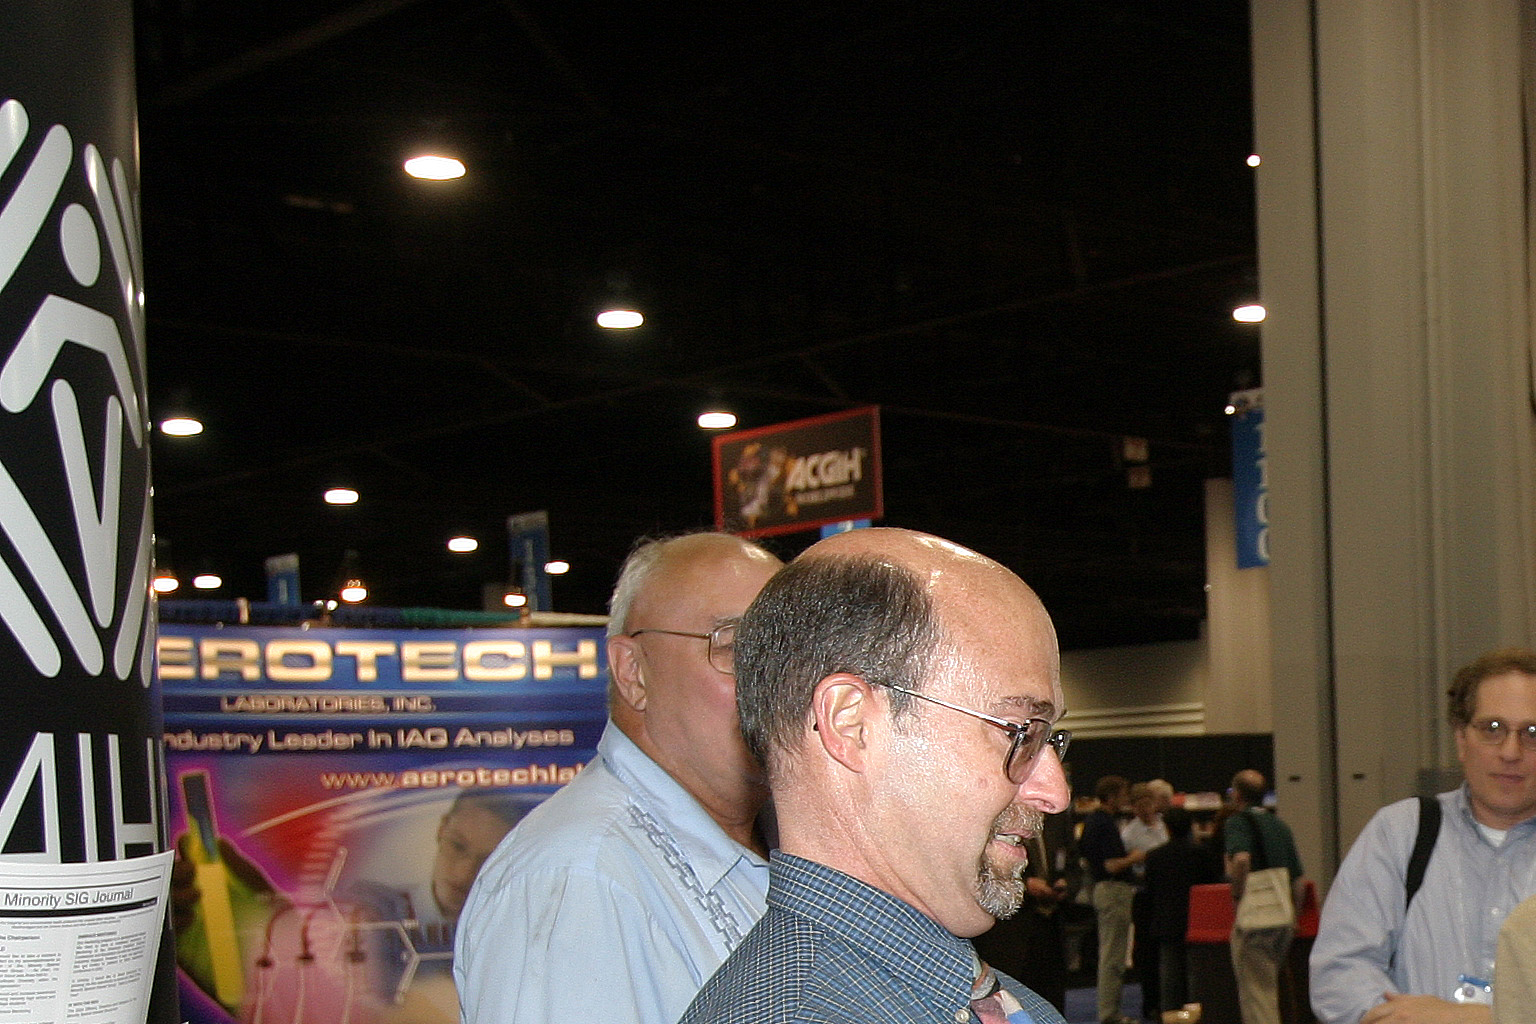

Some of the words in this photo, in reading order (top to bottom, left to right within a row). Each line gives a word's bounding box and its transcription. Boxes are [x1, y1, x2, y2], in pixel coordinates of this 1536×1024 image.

[157, 637, 598, 682] EROTECH
[163, 728, 262, 754] ndustry
[268, 728, 362, 750] Leader
[453, 727, 575, 752] Analyses
[0, 731, 169, 864] AIH
[4, 892, 61, 909] Minority
[65, 891, 89, 906] SIG
[92, 888, 134, 904] Journal
